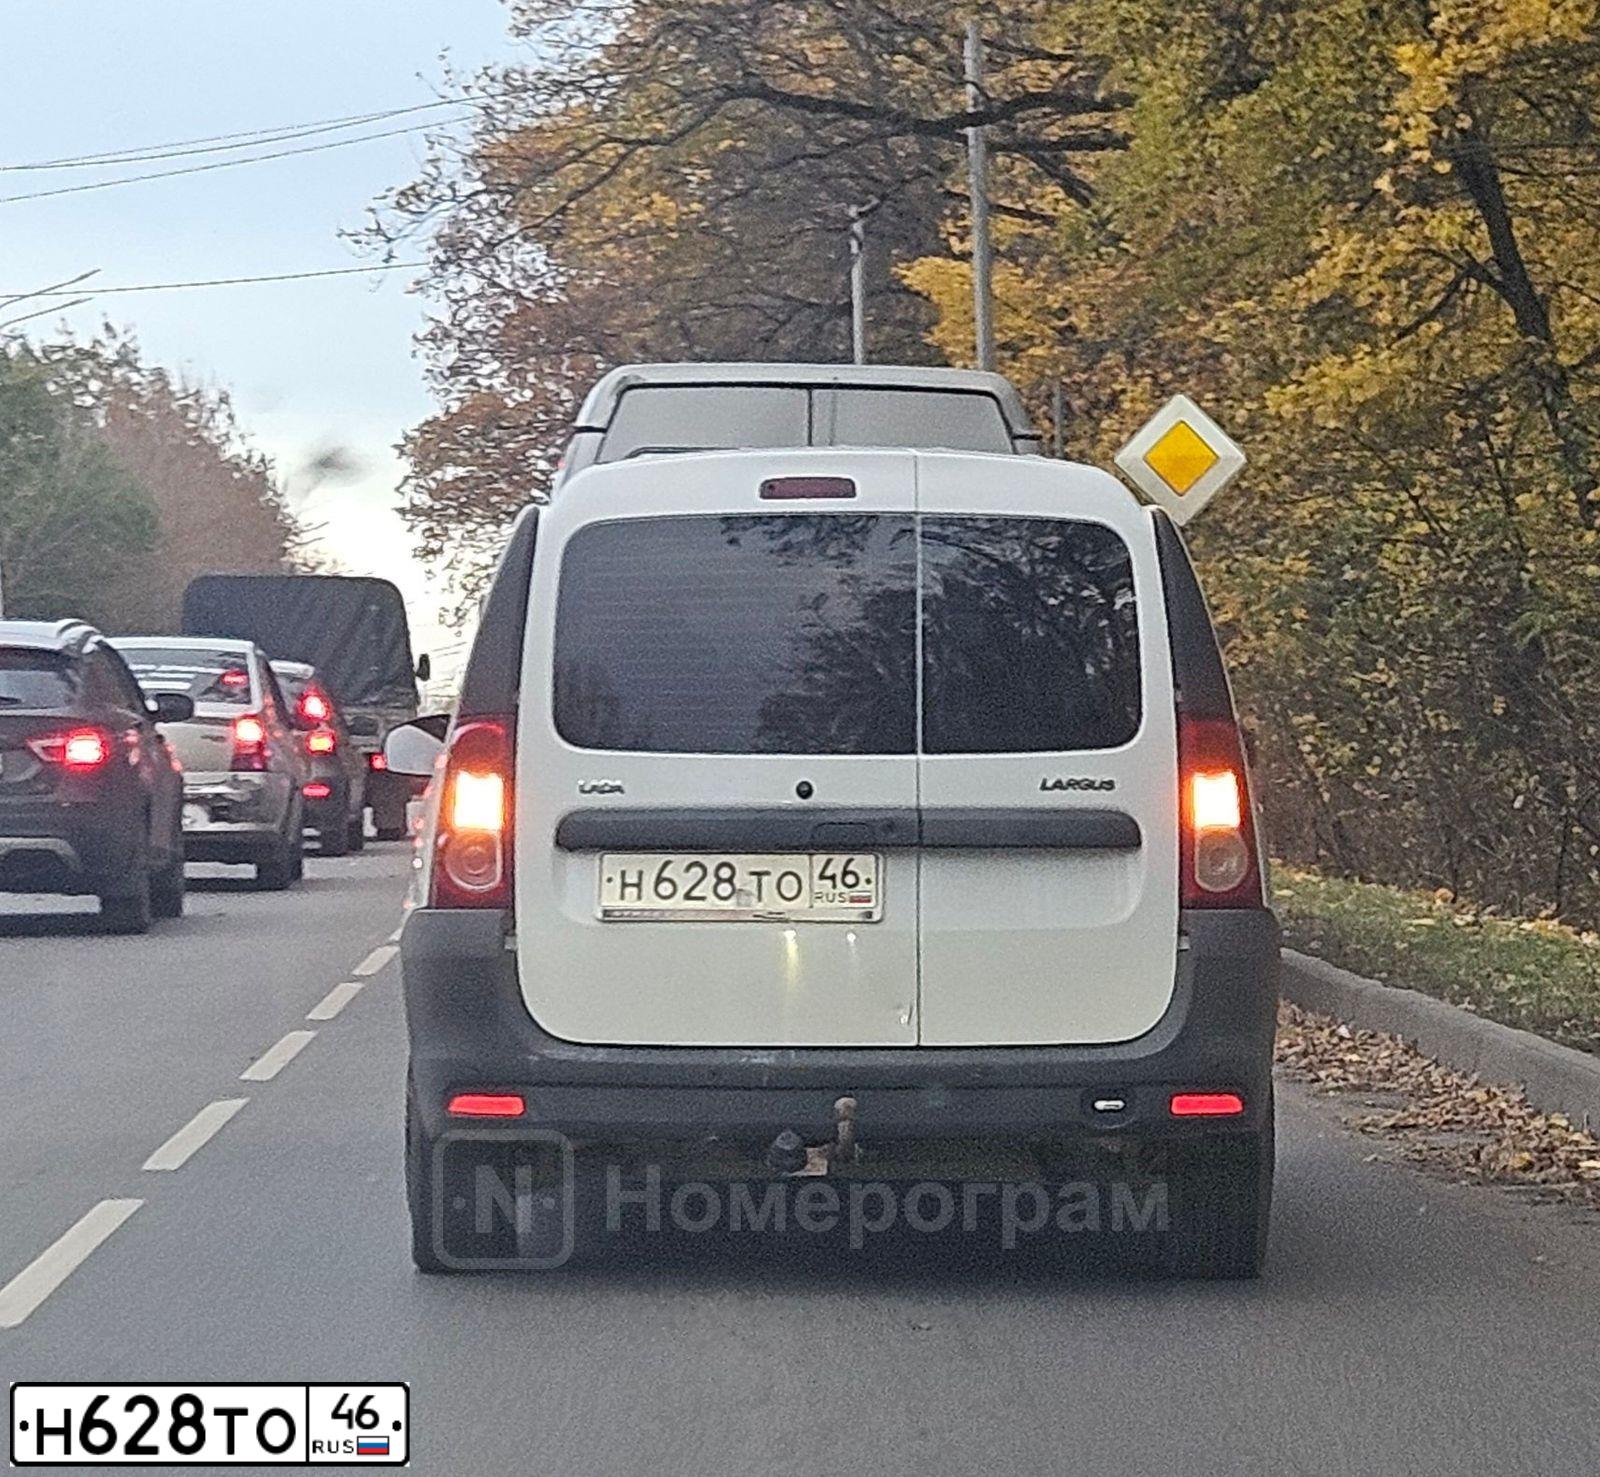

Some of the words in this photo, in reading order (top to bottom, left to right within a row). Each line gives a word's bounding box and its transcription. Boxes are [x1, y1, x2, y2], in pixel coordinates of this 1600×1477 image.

[1040, 778, 1116, 791] LARGUS
[818, 857, 860, 889] 46
[815, 892, 846, 903] RUS
